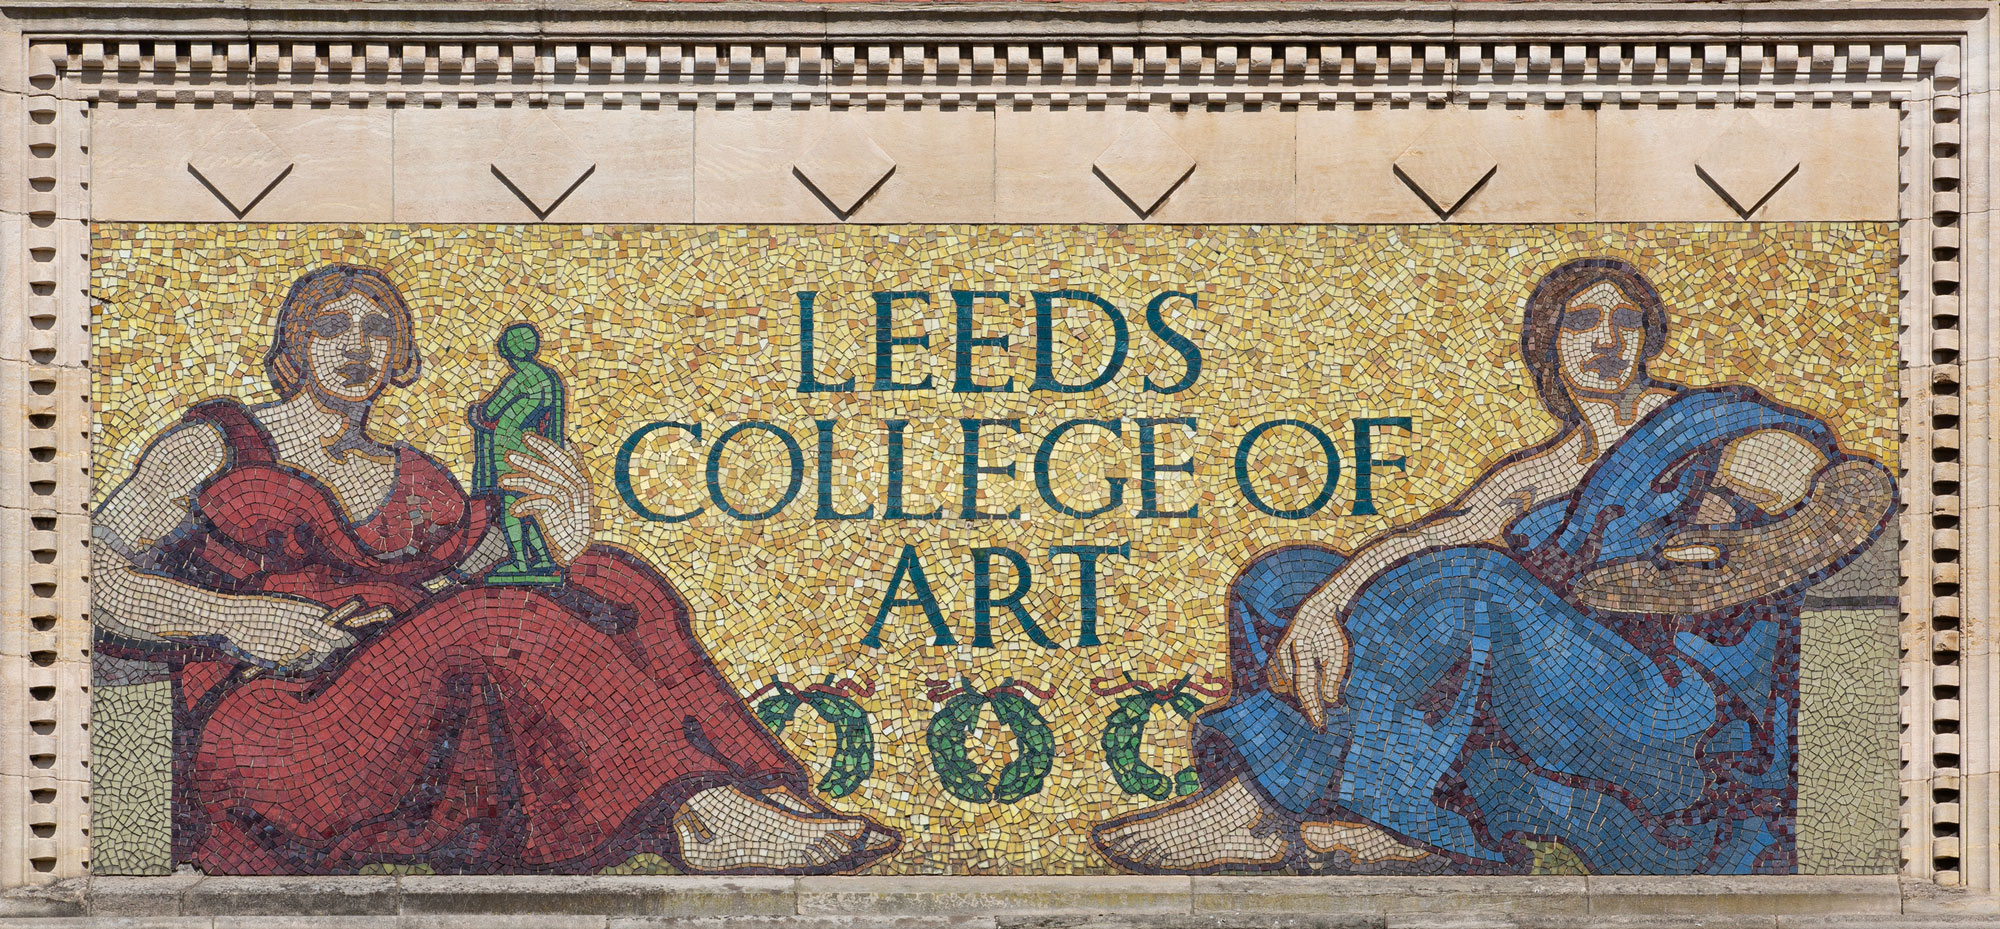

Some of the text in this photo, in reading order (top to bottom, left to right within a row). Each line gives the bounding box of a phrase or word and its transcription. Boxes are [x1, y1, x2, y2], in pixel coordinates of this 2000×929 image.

[797, 290, 1202, 394] LEEDS
[615, 417, 1412, 521] COLLEGE OF
[860, 544, 1130, 649] ART
